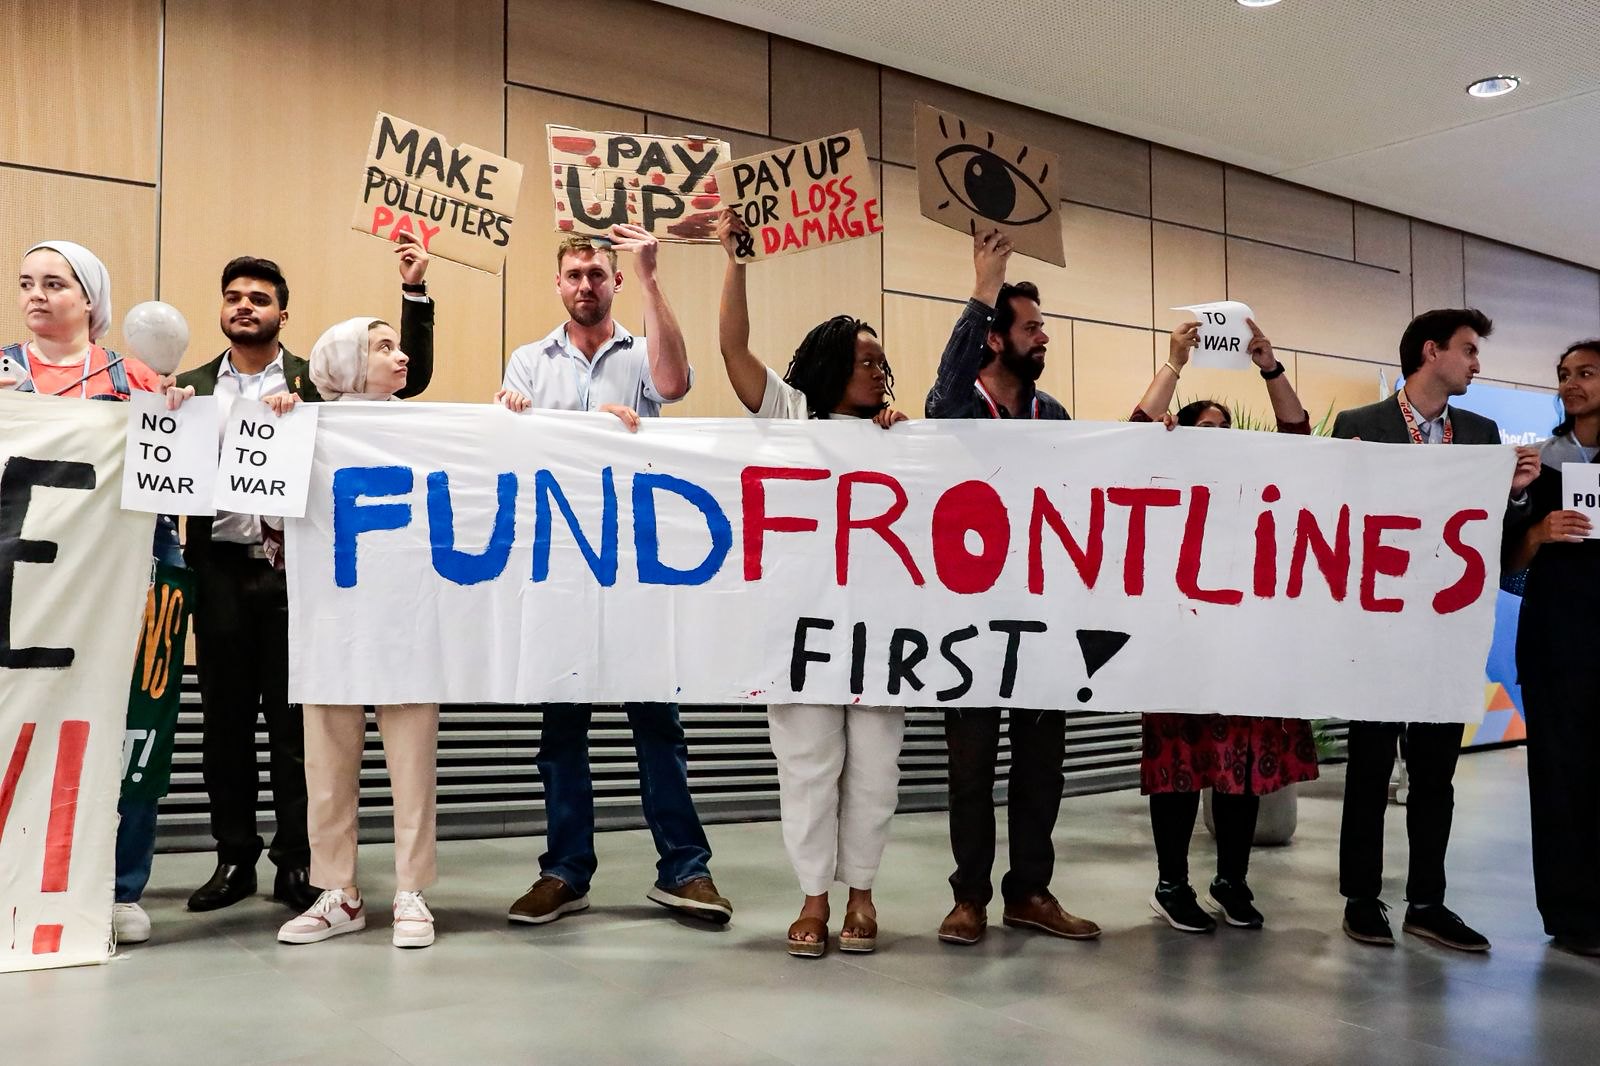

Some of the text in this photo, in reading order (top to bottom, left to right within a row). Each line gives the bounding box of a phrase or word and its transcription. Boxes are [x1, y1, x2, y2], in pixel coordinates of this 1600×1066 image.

[375, 116, 499, 200] MAKE
[607, 136, 720, 193] PAY
[733, 136, 851, 199] PAY UP
[364, 166, 513, 247] POLLUTERS
[566, 166, 686, 232] UP
[790, 175, 859, 218] LOSS
[371, 205, 440, 250] PAY
[735, 198, 884, 258] & DAMAGE
[1202, 312, 1226, 325] TO
[1204, 335, 1241, 352] WAR
[141, 413, 177, 434] NO
[239, 419, 275, 440] NO
[1409, 427, 1423, 444] AY
[139, 442, 172, 463] TO
[235, 447, 267, 466] TO
[137, 472, 194, 494] WAR
[230, 475, 286, 496] WAR
[1573, 493, 1600, 508] PO
[332, 466, 732, 588] FUND
